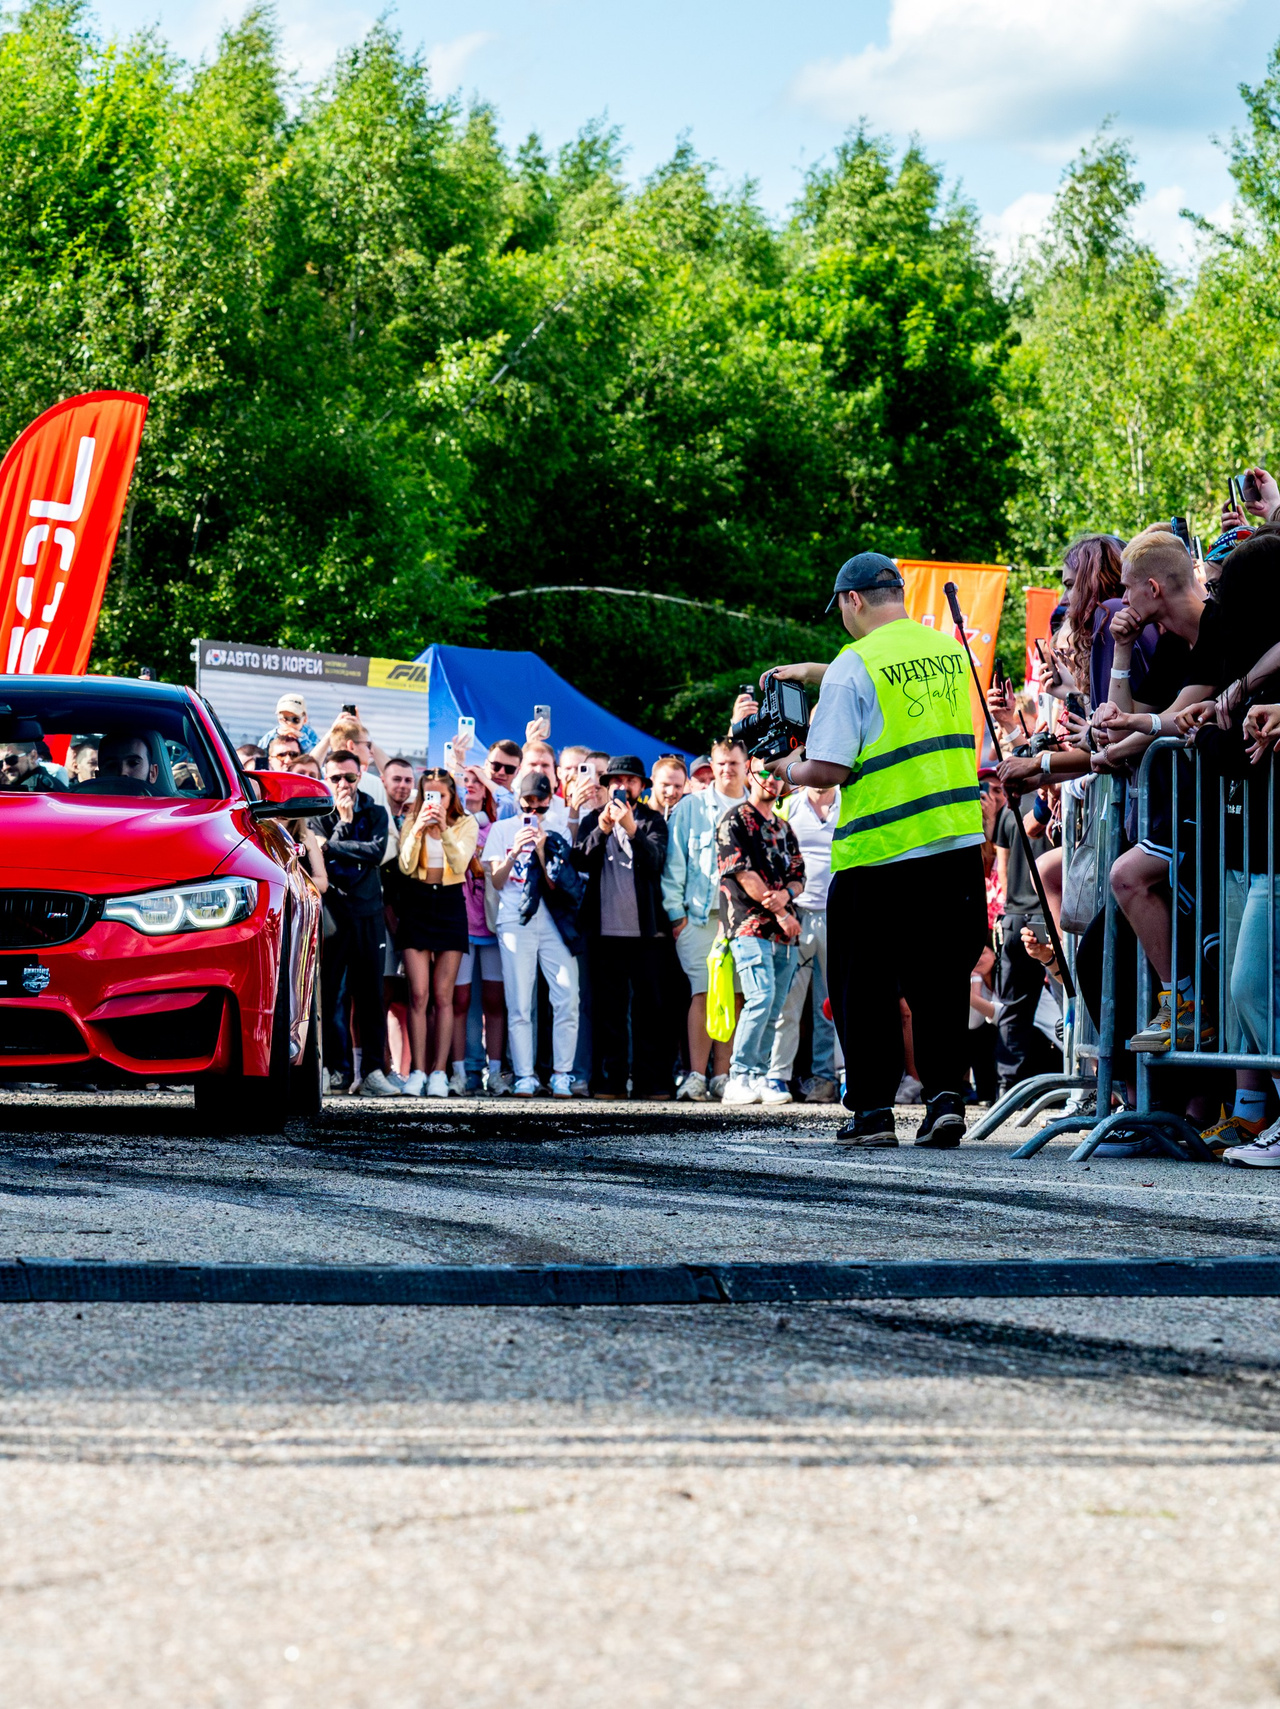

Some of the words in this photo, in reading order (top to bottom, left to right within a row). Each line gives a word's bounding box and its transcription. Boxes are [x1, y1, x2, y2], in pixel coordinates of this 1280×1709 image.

[226, 649, 261, 668] АВТО
[261, 653, 280, 671] ИЗ
[879, 654, 964, 686] WHYNOT
[903, 673, 959, 718] Staff
